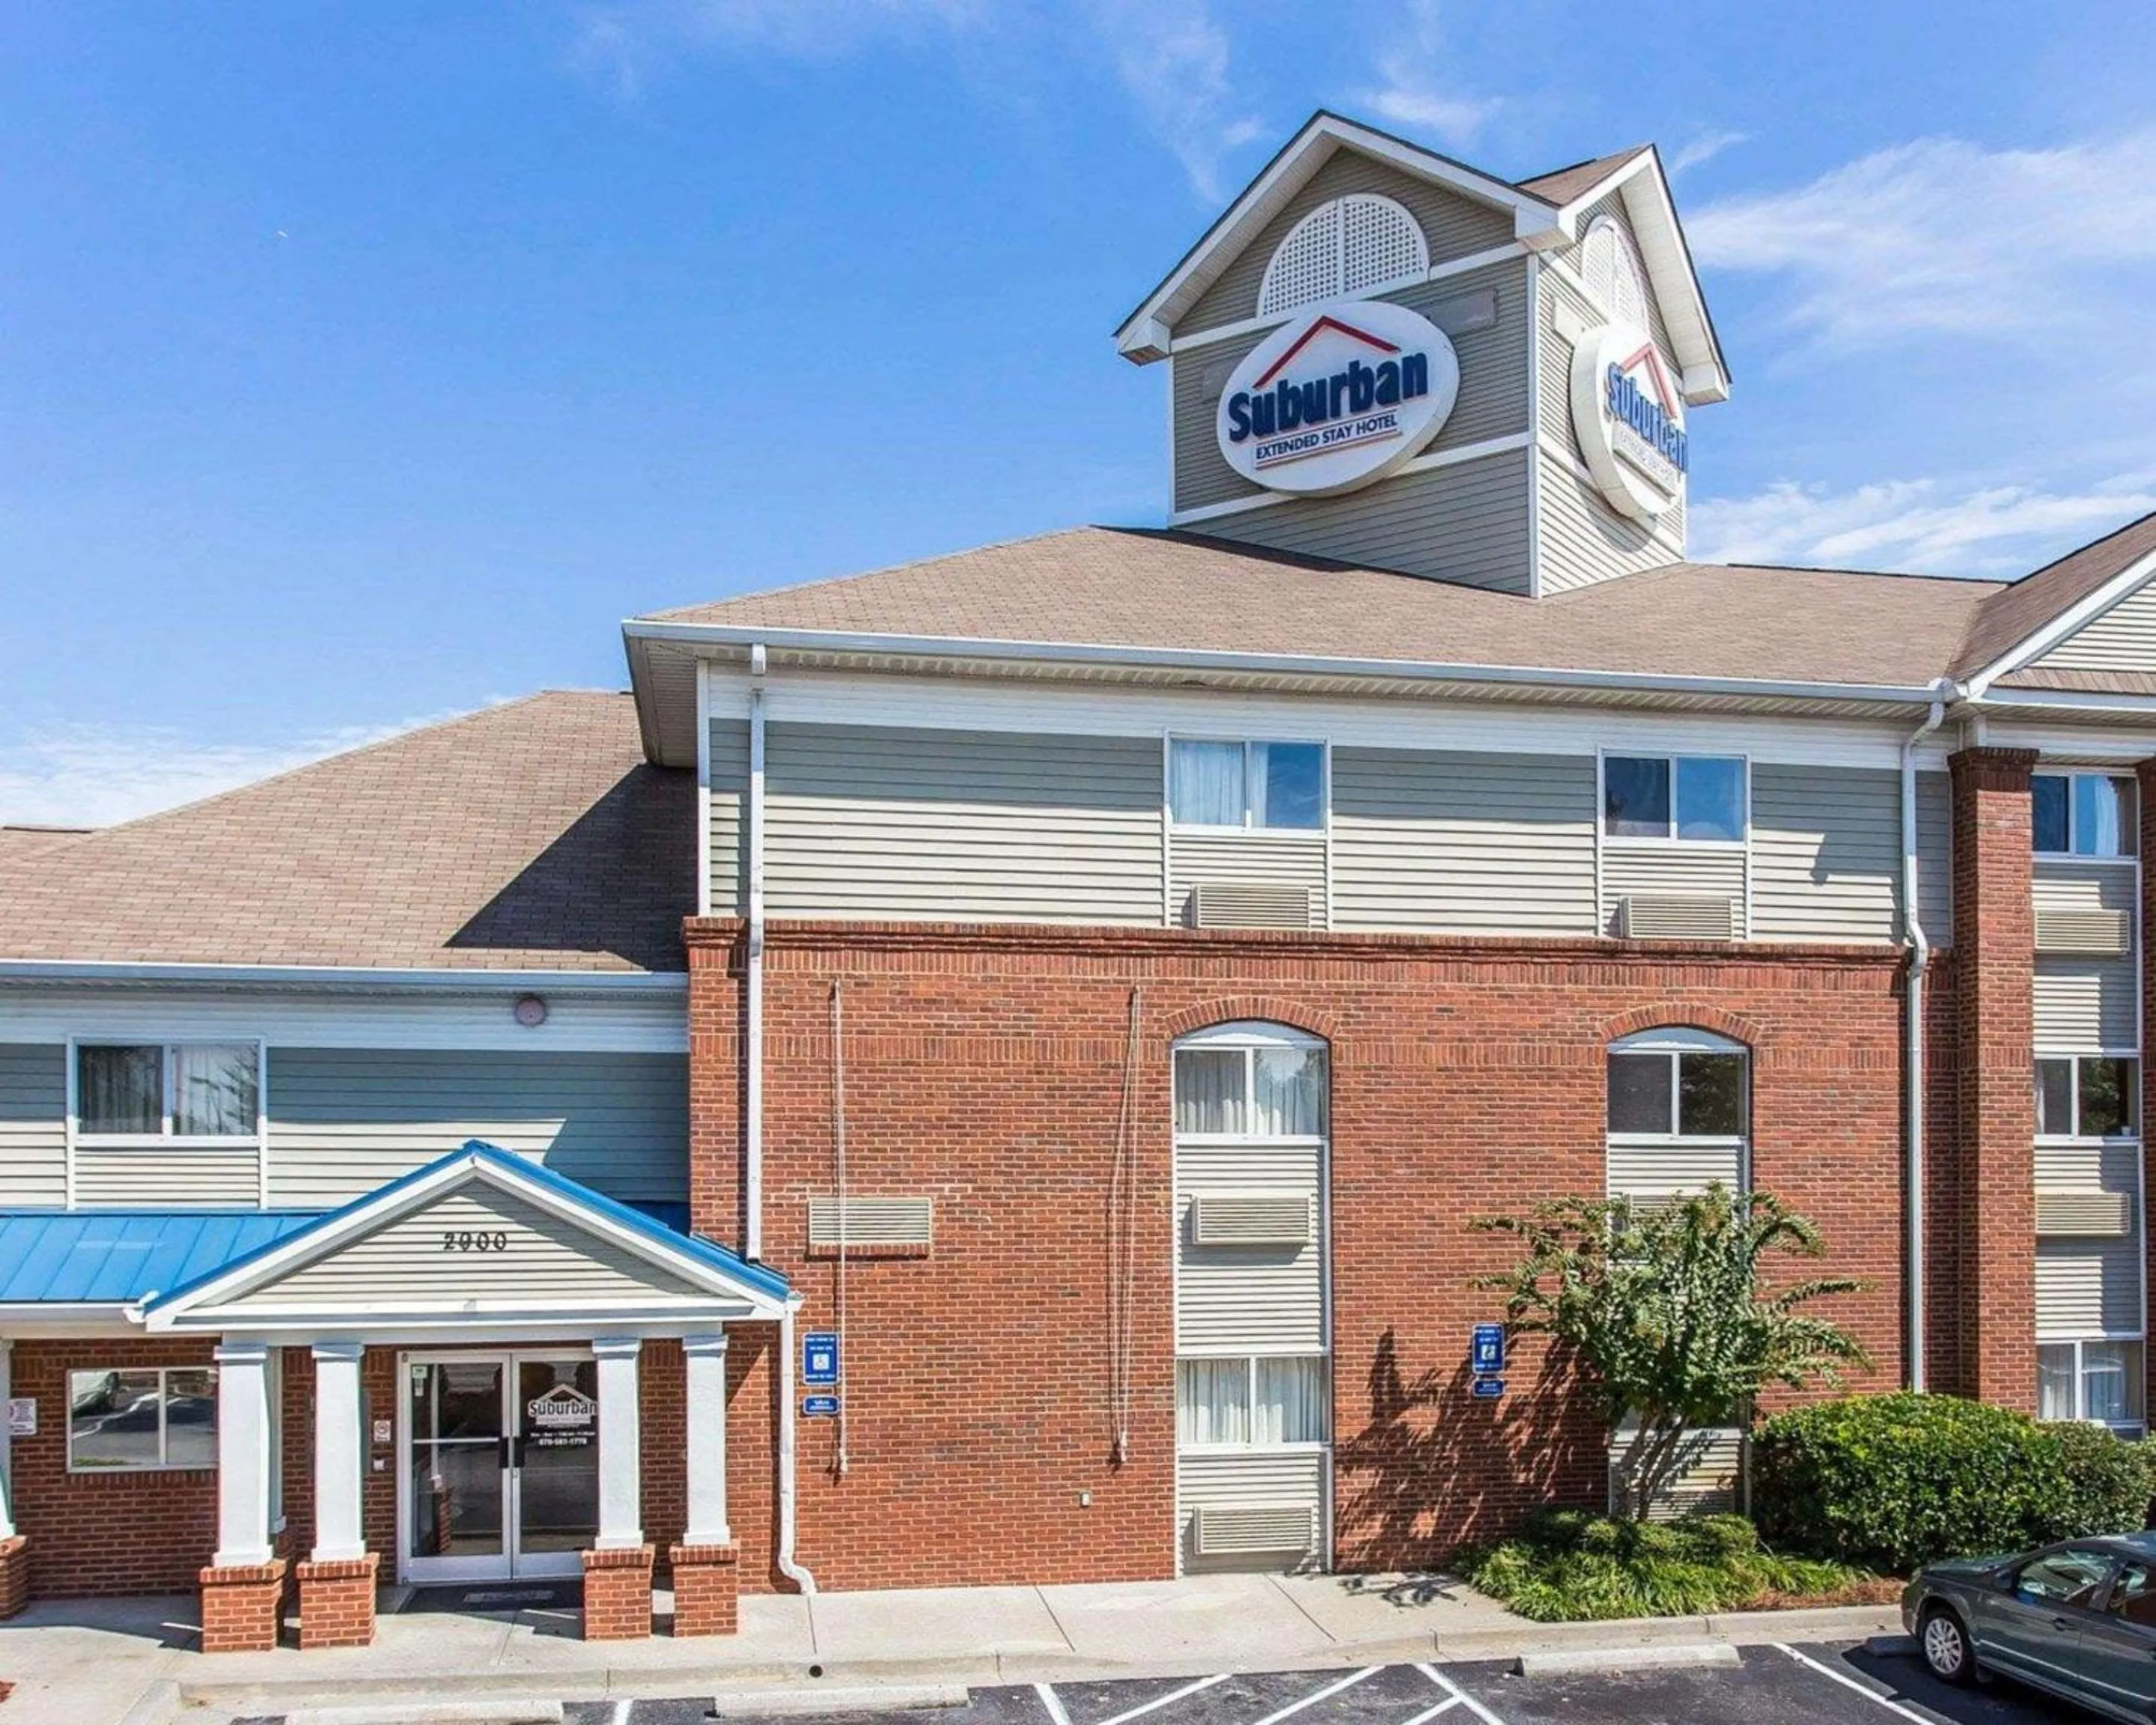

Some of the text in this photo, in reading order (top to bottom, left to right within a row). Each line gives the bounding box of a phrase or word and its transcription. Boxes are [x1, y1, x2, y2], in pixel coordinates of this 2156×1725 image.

[1228, 352, 1428, 442] Suburban
[1607, 362, 1689, 474] Suburban
[1255, 413, 1398, 460] EXTENDED STAY HOTEL
[529, 1399, 597, 1417] Suburban
